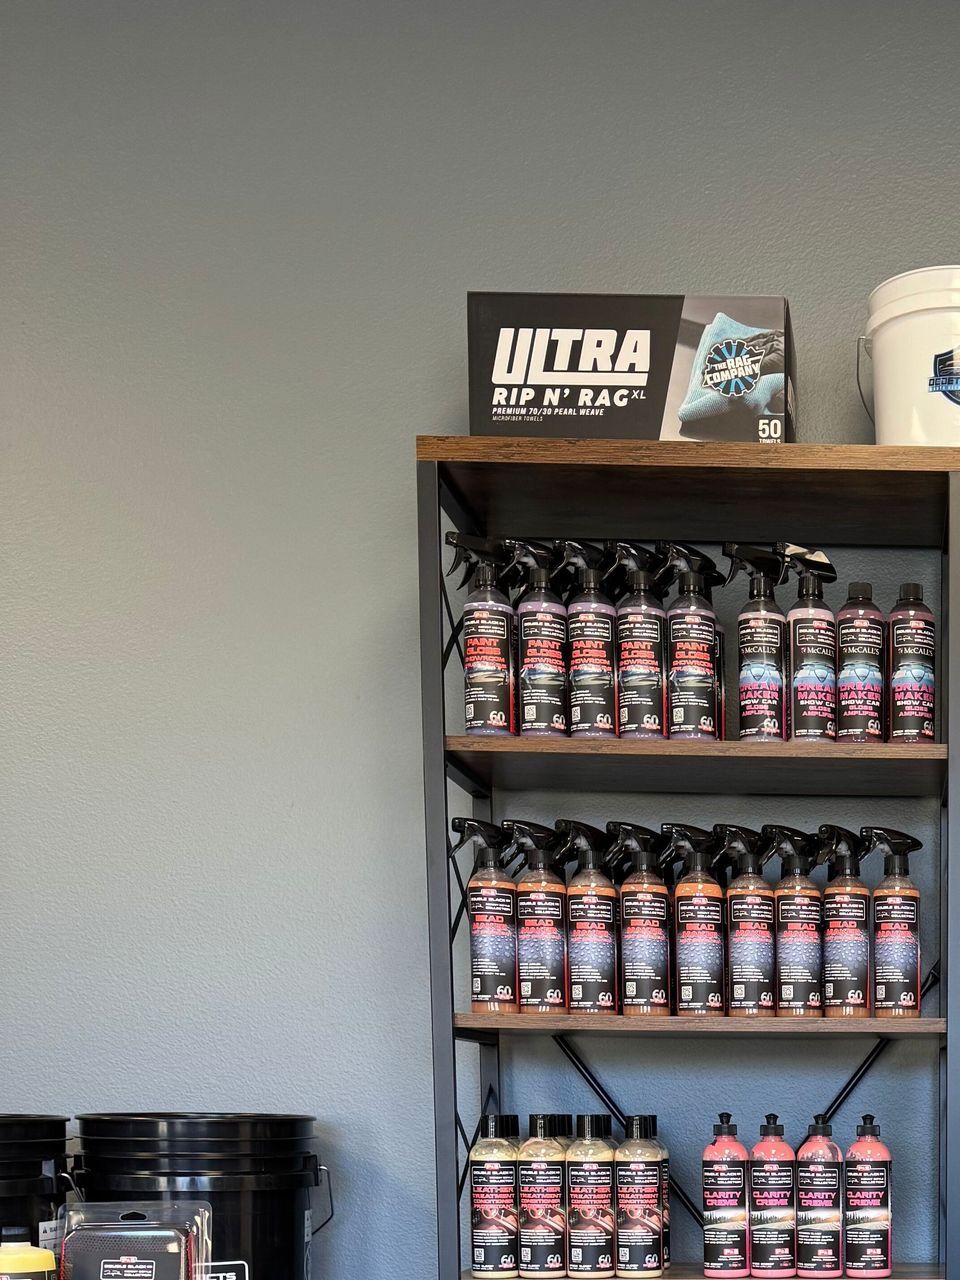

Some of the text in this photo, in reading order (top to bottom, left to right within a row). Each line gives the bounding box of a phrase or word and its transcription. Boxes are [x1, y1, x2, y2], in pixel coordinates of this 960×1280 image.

[491, 327, 650, 387] ULTRA
[714, 354, 752, 371] THE RAG
[706, 363, 761, 385] COMPANY
[492, 388, 647, 407] RIP N' RAG XL
[492, 407, 604, 416] PREMIUM 70/30 PEARL WEAVE
[758, 419, 782, 438] 50
[528, 640, 561, 649] PAINT
[573, 640, 605, 649] PAINT
[527, 649, 562, 658] GLOSS
[745, 645, 776, 655] McCALL'S
[848, 646, 880, 656] McCALL'S
[904, 646, 933, 657] McCALL'S
[840, 690, 881, 701] MAKER
[704, 1191, 742, 1199] CLARITY
[752, 1191, 791, 1199] CLARITY
[799, 1192, 836, 1200] CLARITY
[847, 1191, 884, 1199] CLARITY
